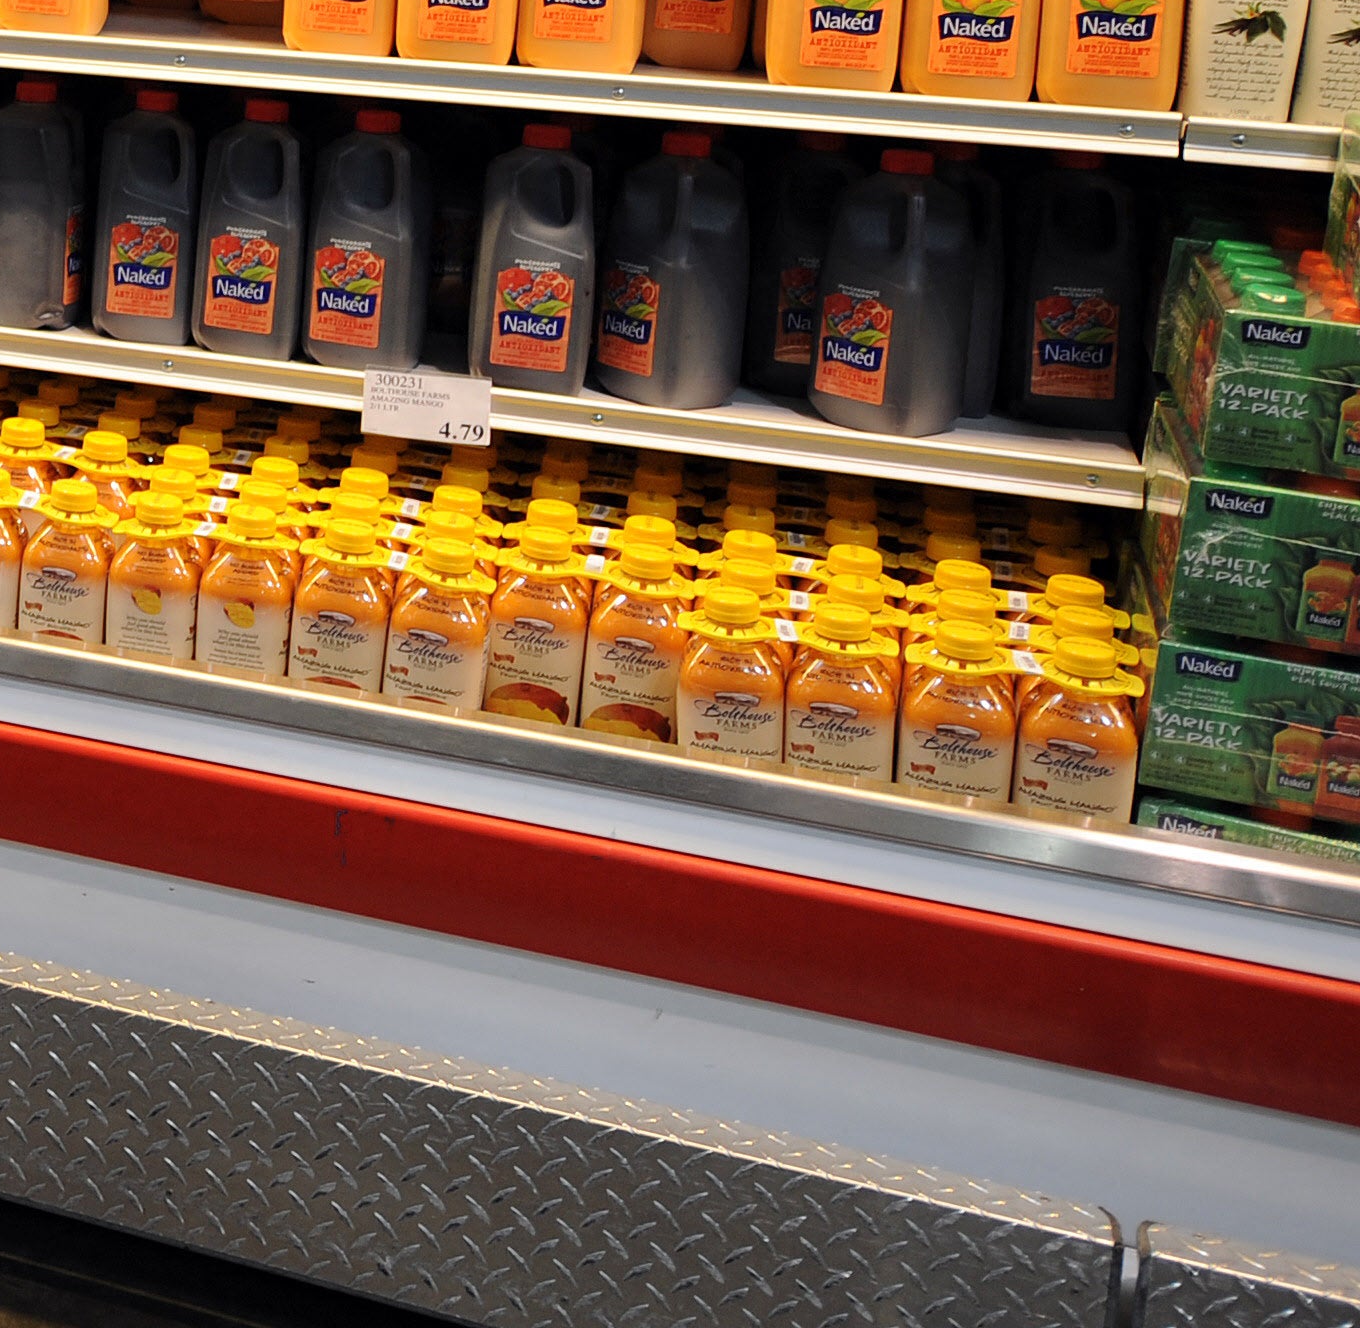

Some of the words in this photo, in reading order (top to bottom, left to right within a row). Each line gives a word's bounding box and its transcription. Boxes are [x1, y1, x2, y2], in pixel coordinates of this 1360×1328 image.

[815, 11, 874, 31] Naked
[944, 18, 1005, 38] Naked
[1082, 16, 1146, 36] Naked
[117, 267, 165, 286] Naked
[216, 280, 265, 301] Naked
[321, 292, 369, 313] Naked
[504, 315, 558, 336] Naked
[605, 316, 645, 340] Naked
[1247, 324, 1302, 344] Naked
[826, 342, 875, 367] Naked
[1045, 344, 1103, 364] Naked
[375, 374, 423, 389] 300231
[371, 387, 420, 397] BOLTHOUSE
[422, 392, 450, 400] FARMS
[371, 395, 409, 404] AMAZING
[412, 400, 444, 408] MANGO
[1220, 382, 1308, 404] VARIETY
[1218, 399, 1309, 420] 12-PACK
[439, 422, 484, 441] 4.79
[1211, 493, 1264, 514] Naked
[1184, 550, 1271, 575] VARIETY
[1183, 567, 1272, 589] 12-PACK
[1181, 656, 1235, 677] Naked
[695, 700, 776, 723] Bolthouse
[1153, 708, 1242, 736] VARIETY
[715, 719, 757, 730] FARMS
[791, 710, 876, 737] Bolthouse
[812, 731, 854, 743] FARMS
[914, 731, 998, 759] Bolthouse
[1155, 727, 1242, 751] 12-PACK
[934, 751, 976, 765] FARMS
[1026, 744, 1115, 777] Bolthouse
[1047, 767, 1092, 782] FARMS
